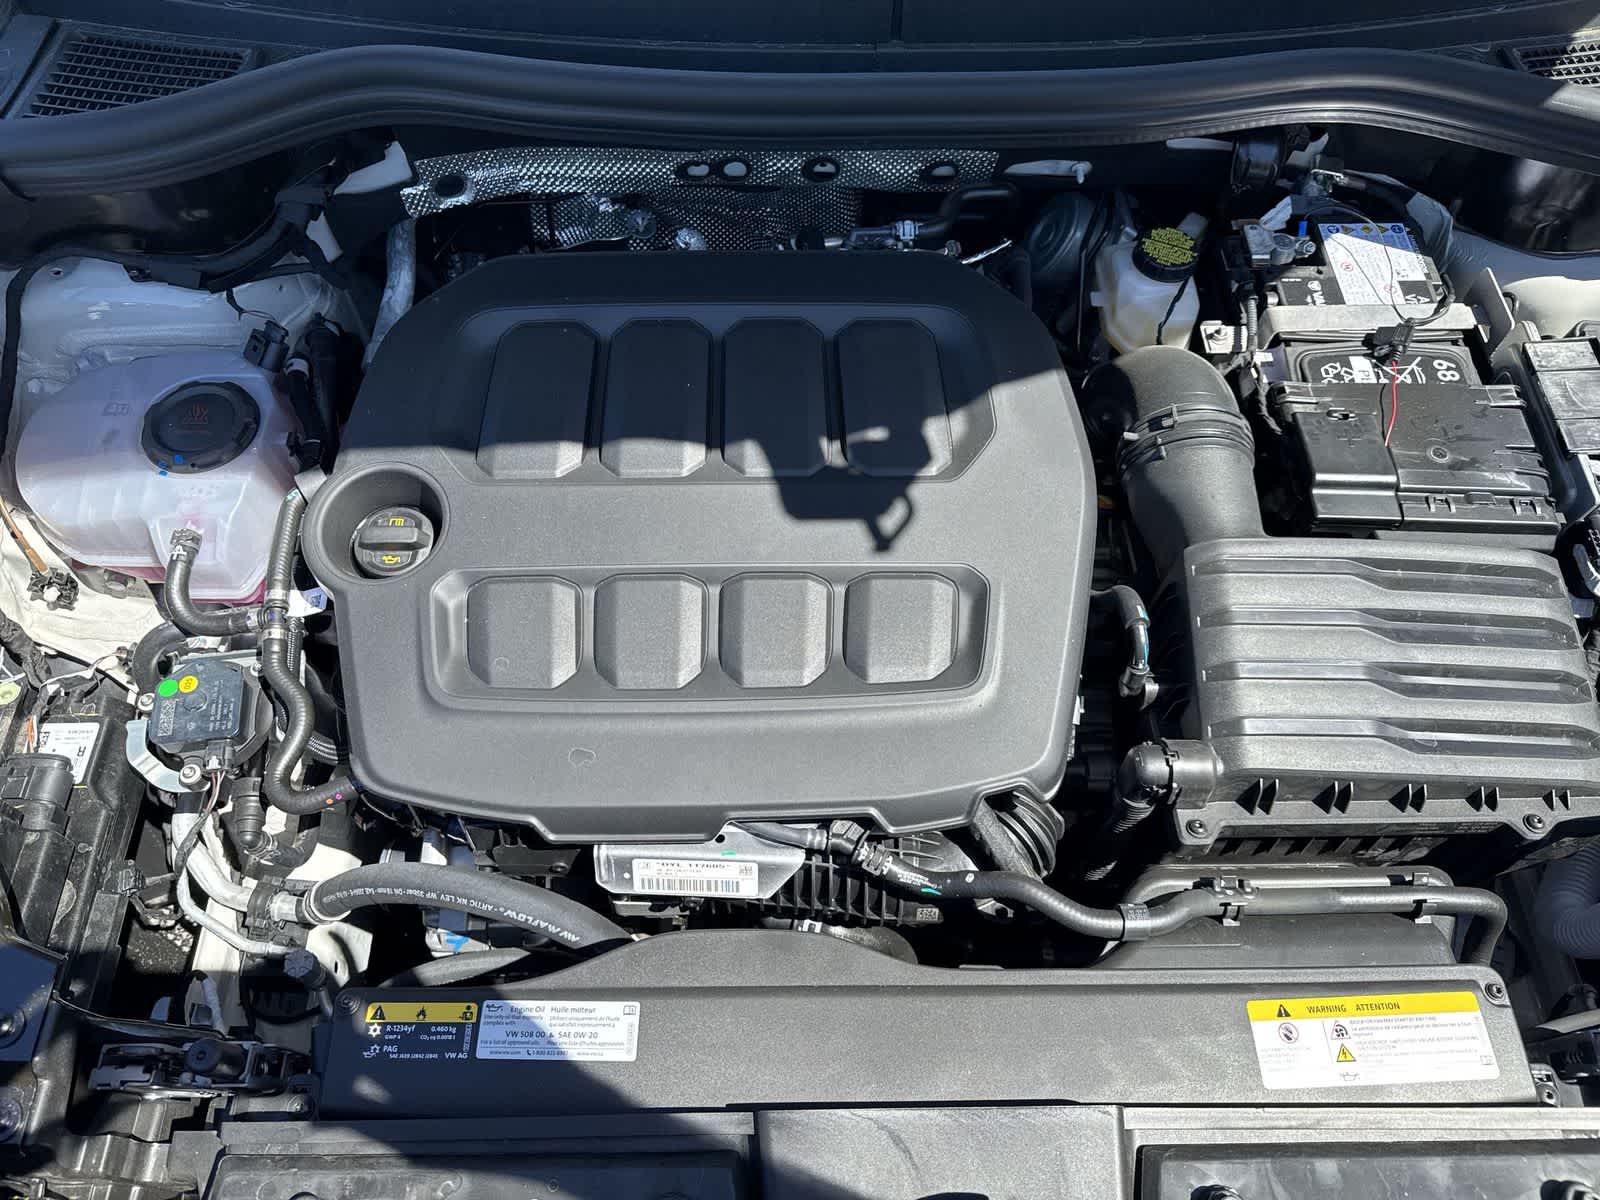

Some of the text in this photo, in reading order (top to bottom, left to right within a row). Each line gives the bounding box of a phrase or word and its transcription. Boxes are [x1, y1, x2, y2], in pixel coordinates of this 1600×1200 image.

[1432, 360, 1460, 381] 68
[510, 1006, 533, 1015] Engine
[534, 1006, 546, 1014] Oil
[550, 1006, 569, 1014] Huile
[1306, 1002, 1400, 1014] WARNING ATTENTION
[386, 1024, 415, 1034] R-1234yf
[505, 1030, 519, 1038] VW
[520, 1030, 534, 1038] 508
[535, 1030, 546, 1038] 00
